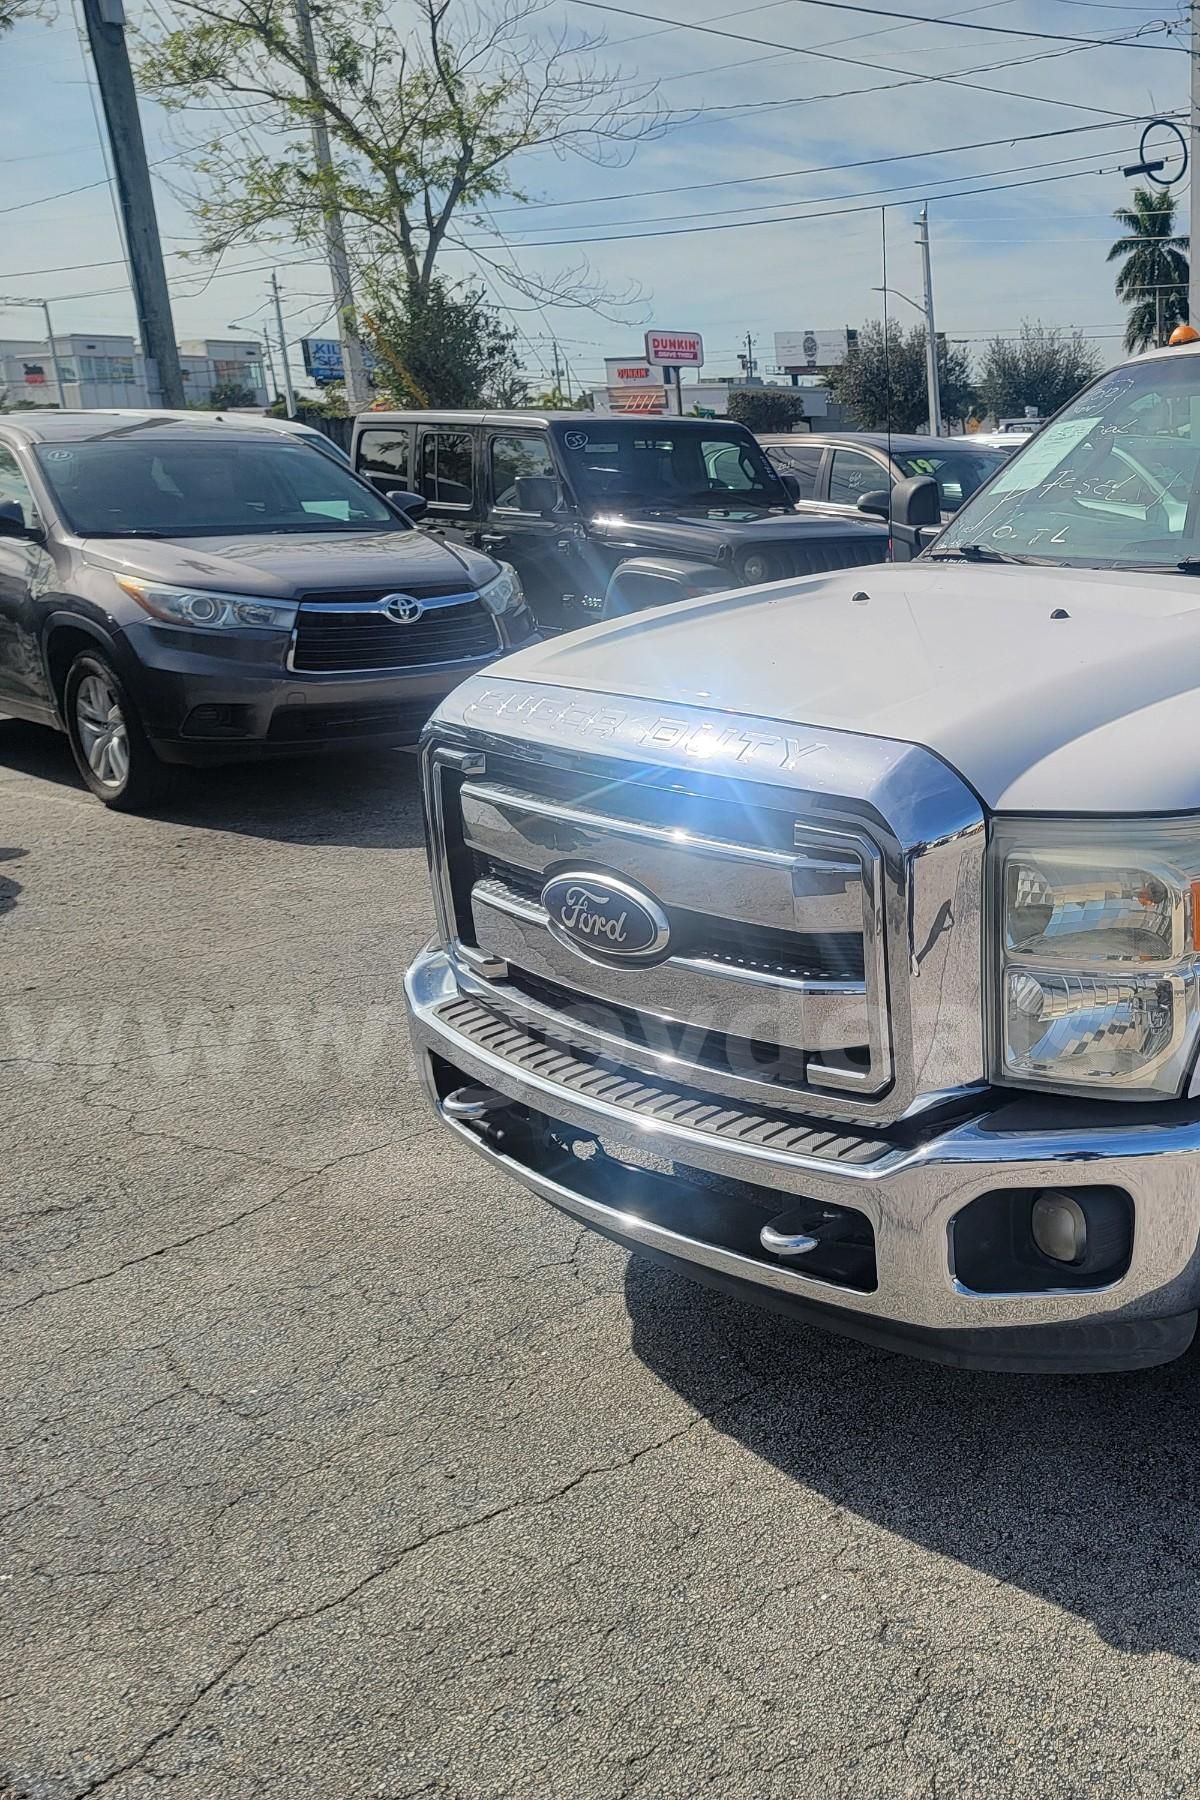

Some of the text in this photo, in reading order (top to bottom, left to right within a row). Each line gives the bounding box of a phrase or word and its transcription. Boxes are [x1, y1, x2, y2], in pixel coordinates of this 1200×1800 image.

[652, 338, 700, 351] DUNKIN'
[907, 458, 934, 474] 19
[462, 688, 832, 772] SUPER DUTY
[560, 886, 628, 942] Ford
